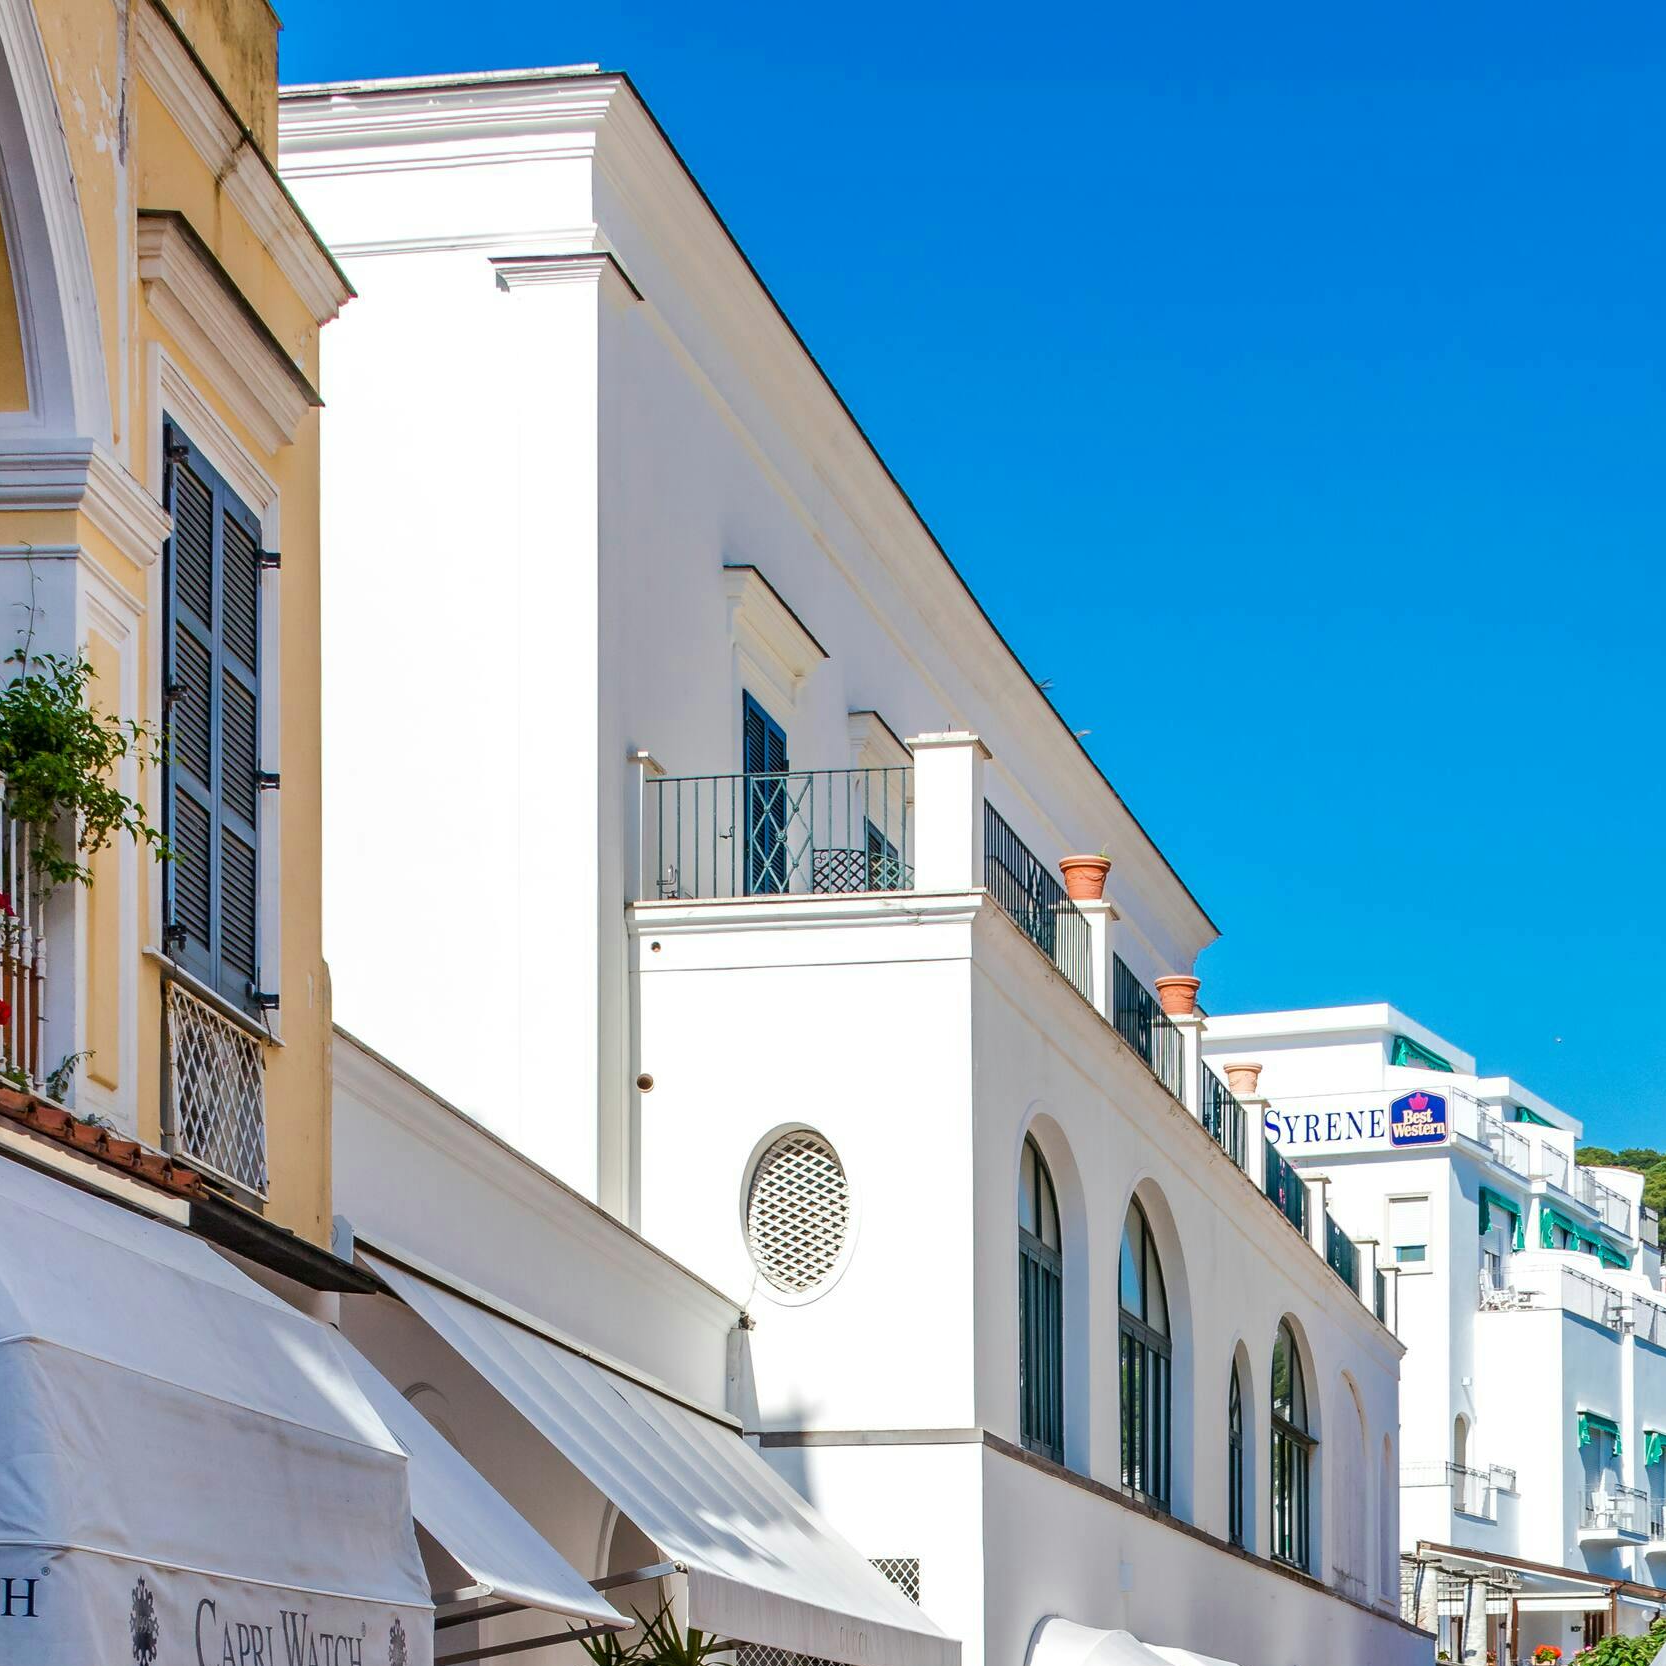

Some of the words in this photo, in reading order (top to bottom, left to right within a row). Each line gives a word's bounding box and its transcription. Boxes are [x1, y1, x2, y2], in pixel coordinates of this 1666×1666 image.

[1402, 1107, 1433, 1124] Best
[1264, 1108, 1386, 1145] SYRENE
[1391, 1121, 1446, 1138] Western
